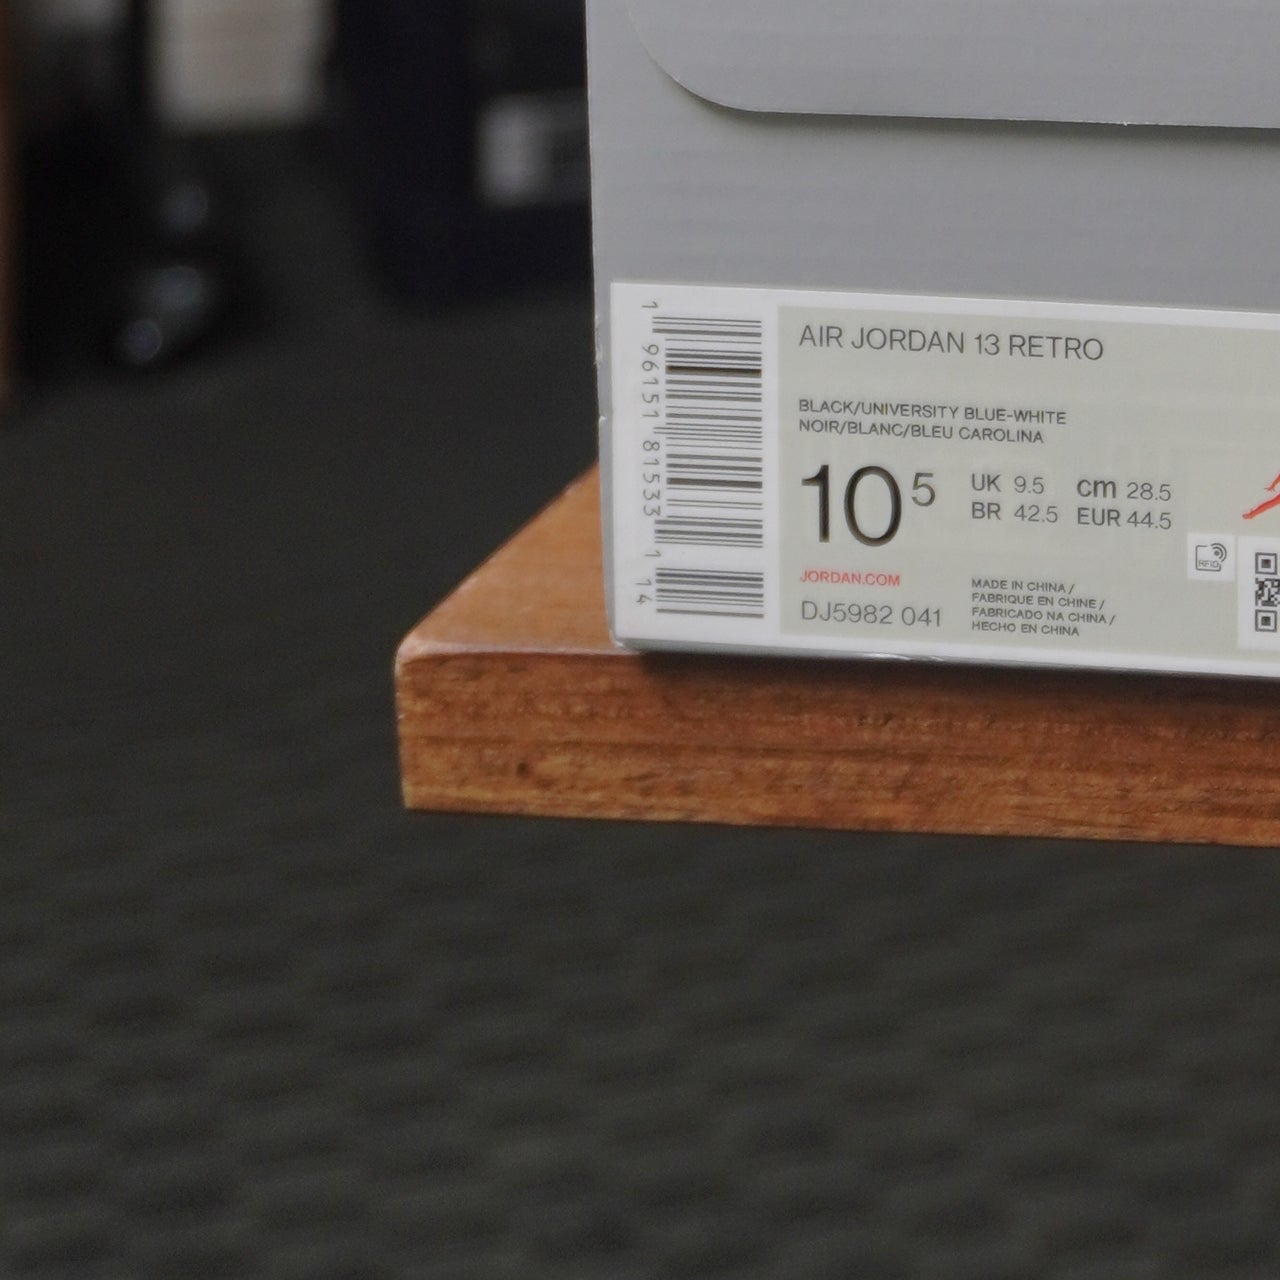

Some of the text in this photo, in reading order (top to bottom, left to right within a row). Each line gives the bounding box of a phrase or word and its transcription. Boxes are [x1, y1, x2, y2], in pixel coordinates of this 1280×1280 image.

[799, 324, 1104, 361] AIR JORDAN 13 RETRO
[799, 399, 1067, 425] BLACK/UNIVERSITY BLUE-WHITE
[642, 301, 661, 558] 1 96151 81533 1
[799, 419, 1044, 444] NOIR/BLANC/BLEU CAROLINA
[971, 473, 1172, 502] UK 9.5 cm 28.5
[971, 502, 1172, 530] BR 42.5 EUR 44.5
[799, 569, 901, 587] JORDAN.COM
[971, 578, 1008, 590] MADE
[1011, 580, 1023, 591] IN
[1026, 581, 1066, 593] CHINA
[636, 579, 653, 605] 14
[971, 592, 1034, 606] FABRIQUE
[1037, 596, 1054, 607] EN
[1058, 597, 1097, 609] CHINE
[801, 600, 943, 628] DJ5982 041
[971, 607, 1043, 620] FABRICADO
[1046, 612, 1064, 622] NA
[1068, 612, 1107, 624] CHINA
[971, 621, 1080, 637] HECHO EN CHINA
